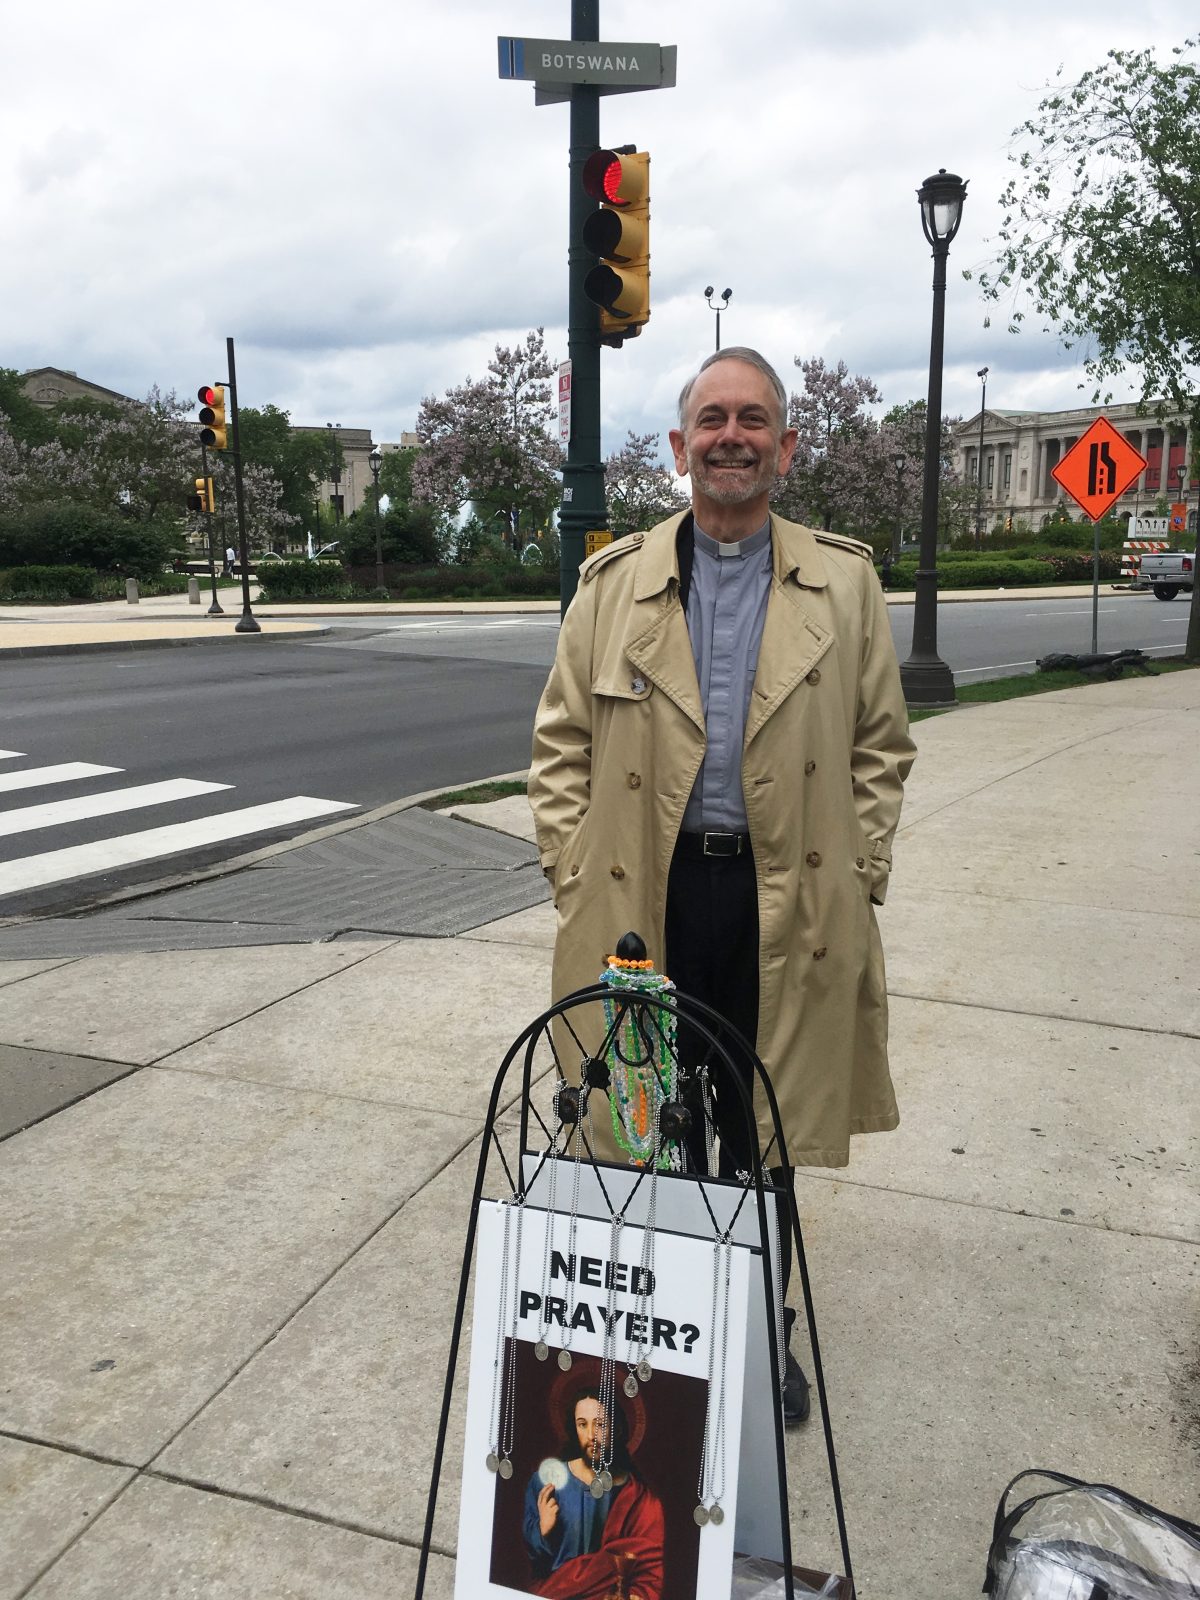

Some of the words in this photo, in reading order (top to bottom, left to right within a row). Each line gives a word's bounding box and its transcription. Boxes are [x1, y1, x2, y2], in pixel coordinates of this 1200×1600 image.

[541, 53, 640, 71] BOTSWANA
[550, 1250, 656, 1297] NEED
[519, 1290, 701, 1354] PRAYER?
